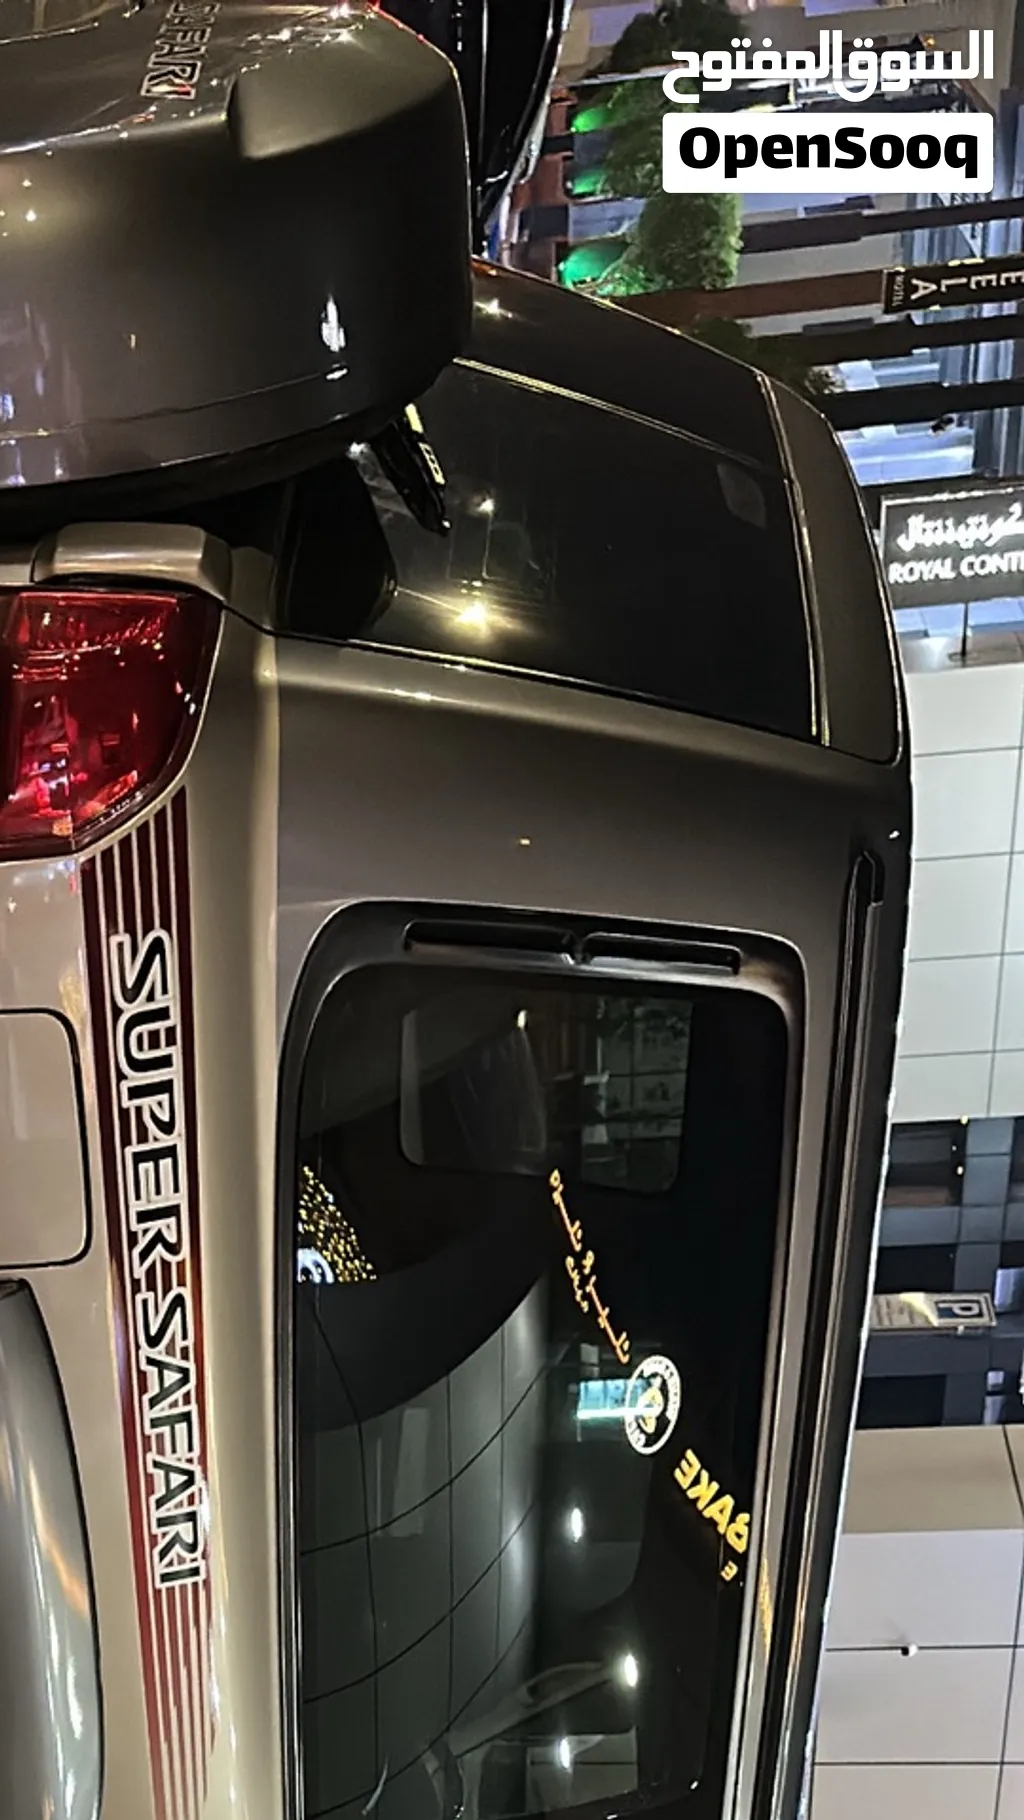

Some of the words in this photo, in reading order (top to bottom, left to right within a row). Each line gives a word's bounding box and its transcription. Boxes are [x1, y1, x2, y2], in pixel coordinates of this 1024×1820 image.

[888, 557, 956, 584] ROYAL
[110, 930, 187, 1278] SUPER
[937, 1303, 980, 1316] P
[136, 1288, 206, 1589] SAFARI
